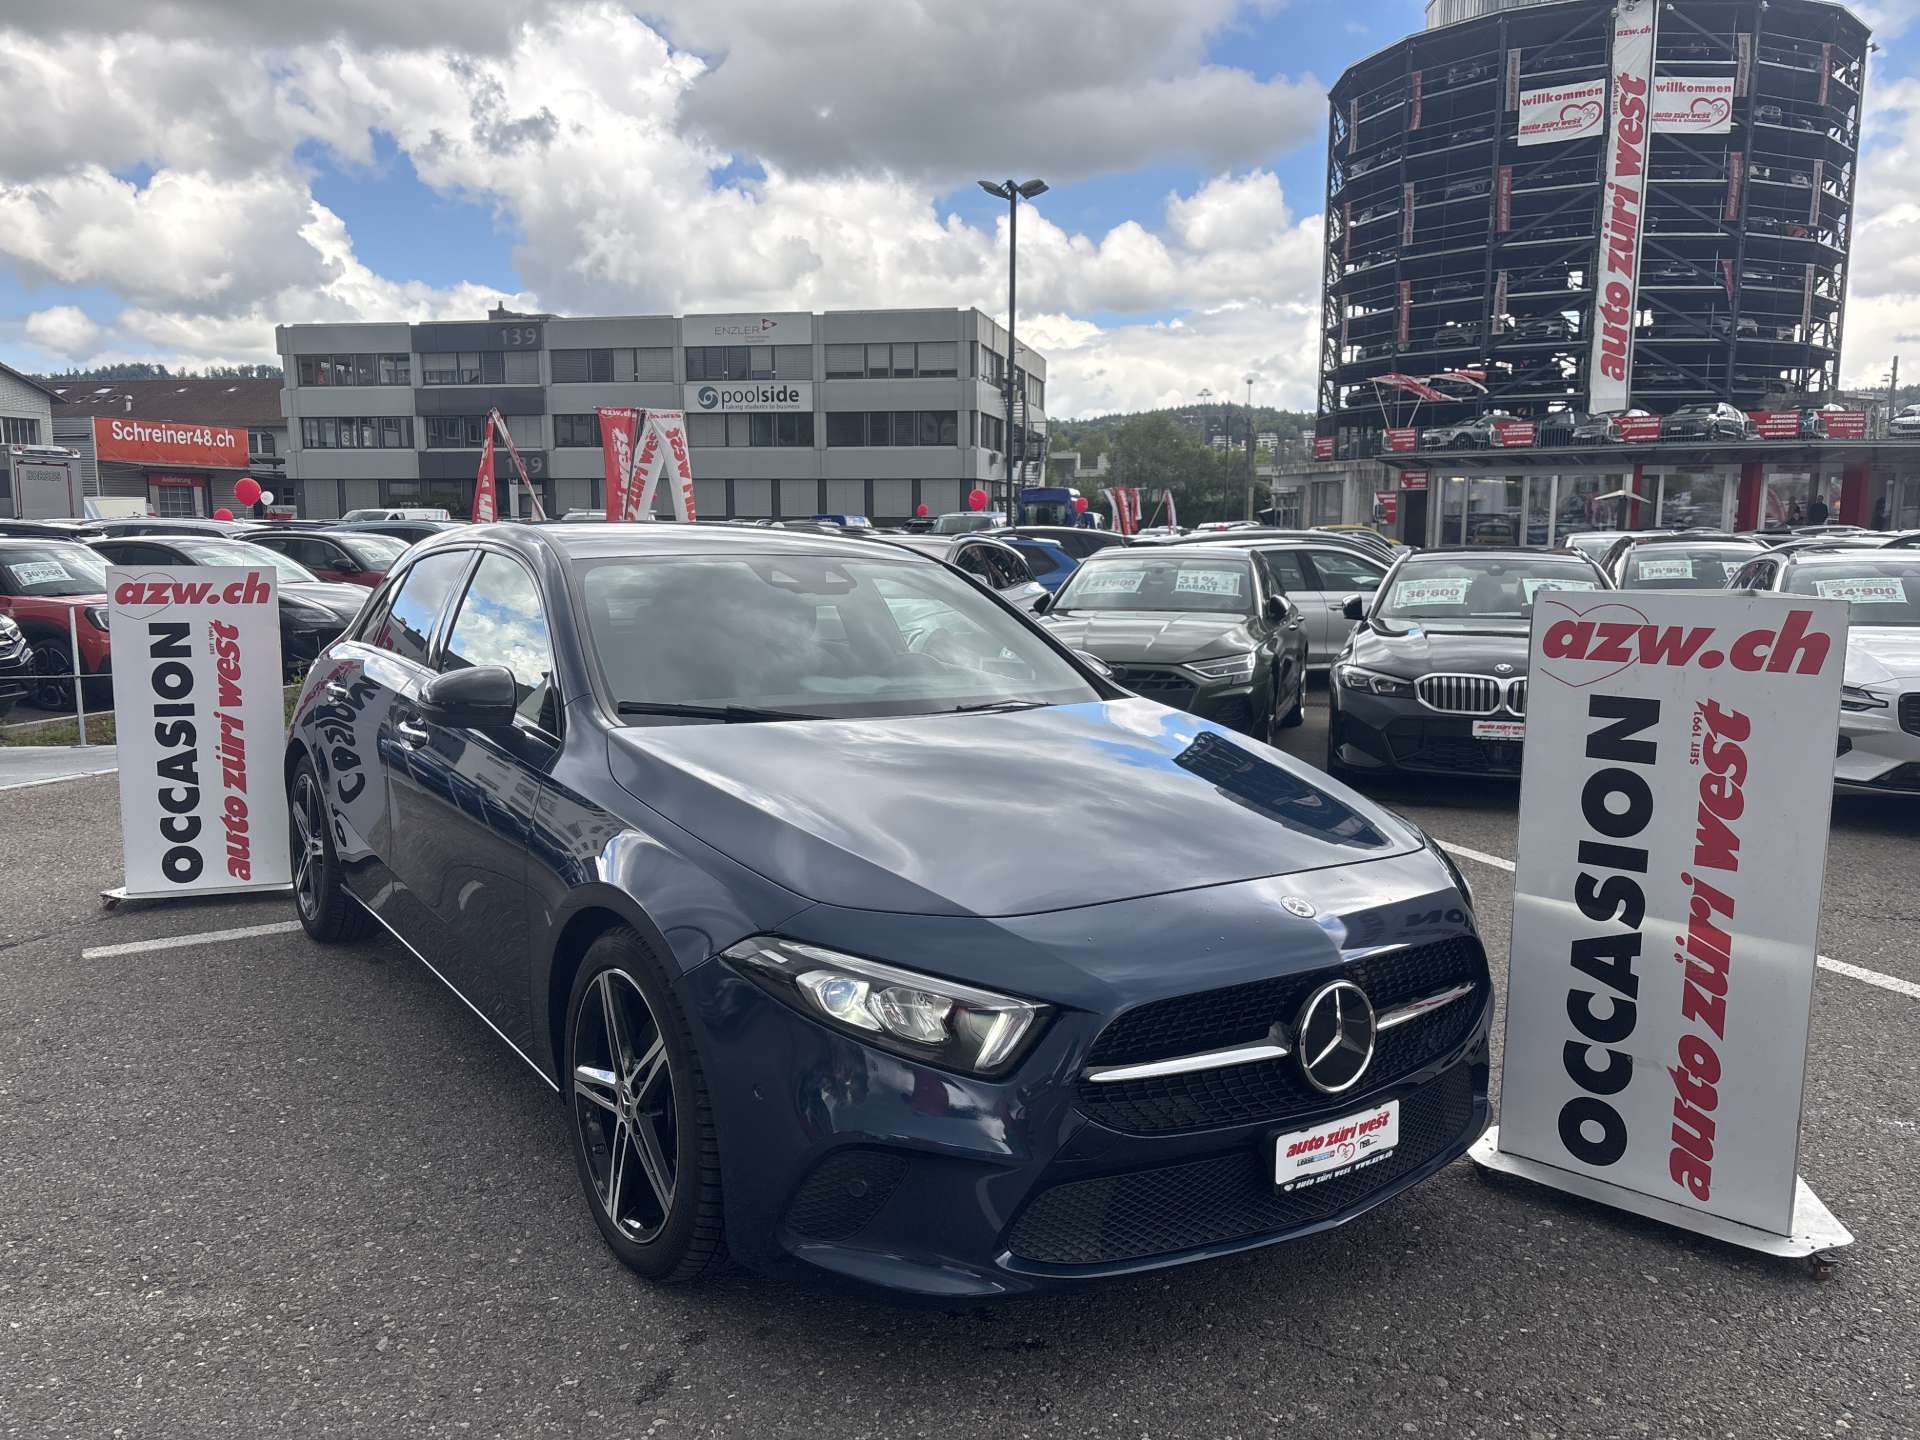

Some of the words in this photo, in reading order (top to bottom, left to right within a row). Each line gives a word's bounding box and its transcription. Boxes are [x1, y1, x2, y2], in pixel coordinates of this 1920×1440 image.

[1616, 26, 1651, 37] azw.ch
[1521, 88, 1603, 107] willkommen
[1655, 82, 1732, 93] willkommen
[1615, 72, 1647, 176] west
[1602, 182, 1639, 280] züri
[501, 327, 537, 345] 139
[714, 326, 760, 336] ENZLER
[1599, 281, 1631, 381] auto
[721, 384, 800, 410] poolside
[111, 421, 235, 448] Schreiner48.ch
[506, 456, 543, 474] 19
[114, 571, 271, 606] azw.ch
[1177, 584, 1217, 592] RABATT
[1178, 575, 1218, 586] 31%
[1541, 609, 1831, 677] azw.ch
[209, 619, 243, 707] west
[1691, 711, 1703, 738] 1991
[148, 621, 204, 884] OCCASION
[213, 710, 247, 795] züri
[1690, 742, 1701, 766] SEIT
[1693, 698, 1752, 874] west
[219, 795, 251, 882] auto
[1558, 694, 1662, 1168] OCCASION
[1675, 871, 1737, 1042] züri
[1286, 1135, 1324, 1158] auto
[1325, 1121, 1358, 1148] züri
[1358, 1111, 1391, 1136] west
[1666, 1033, 1723, 1202] auto
[1296, 1178, 1315, 1190] auto
[1316, 1172, 1333, 1183] züri
[1334, 1167, 1352, 1178] west
